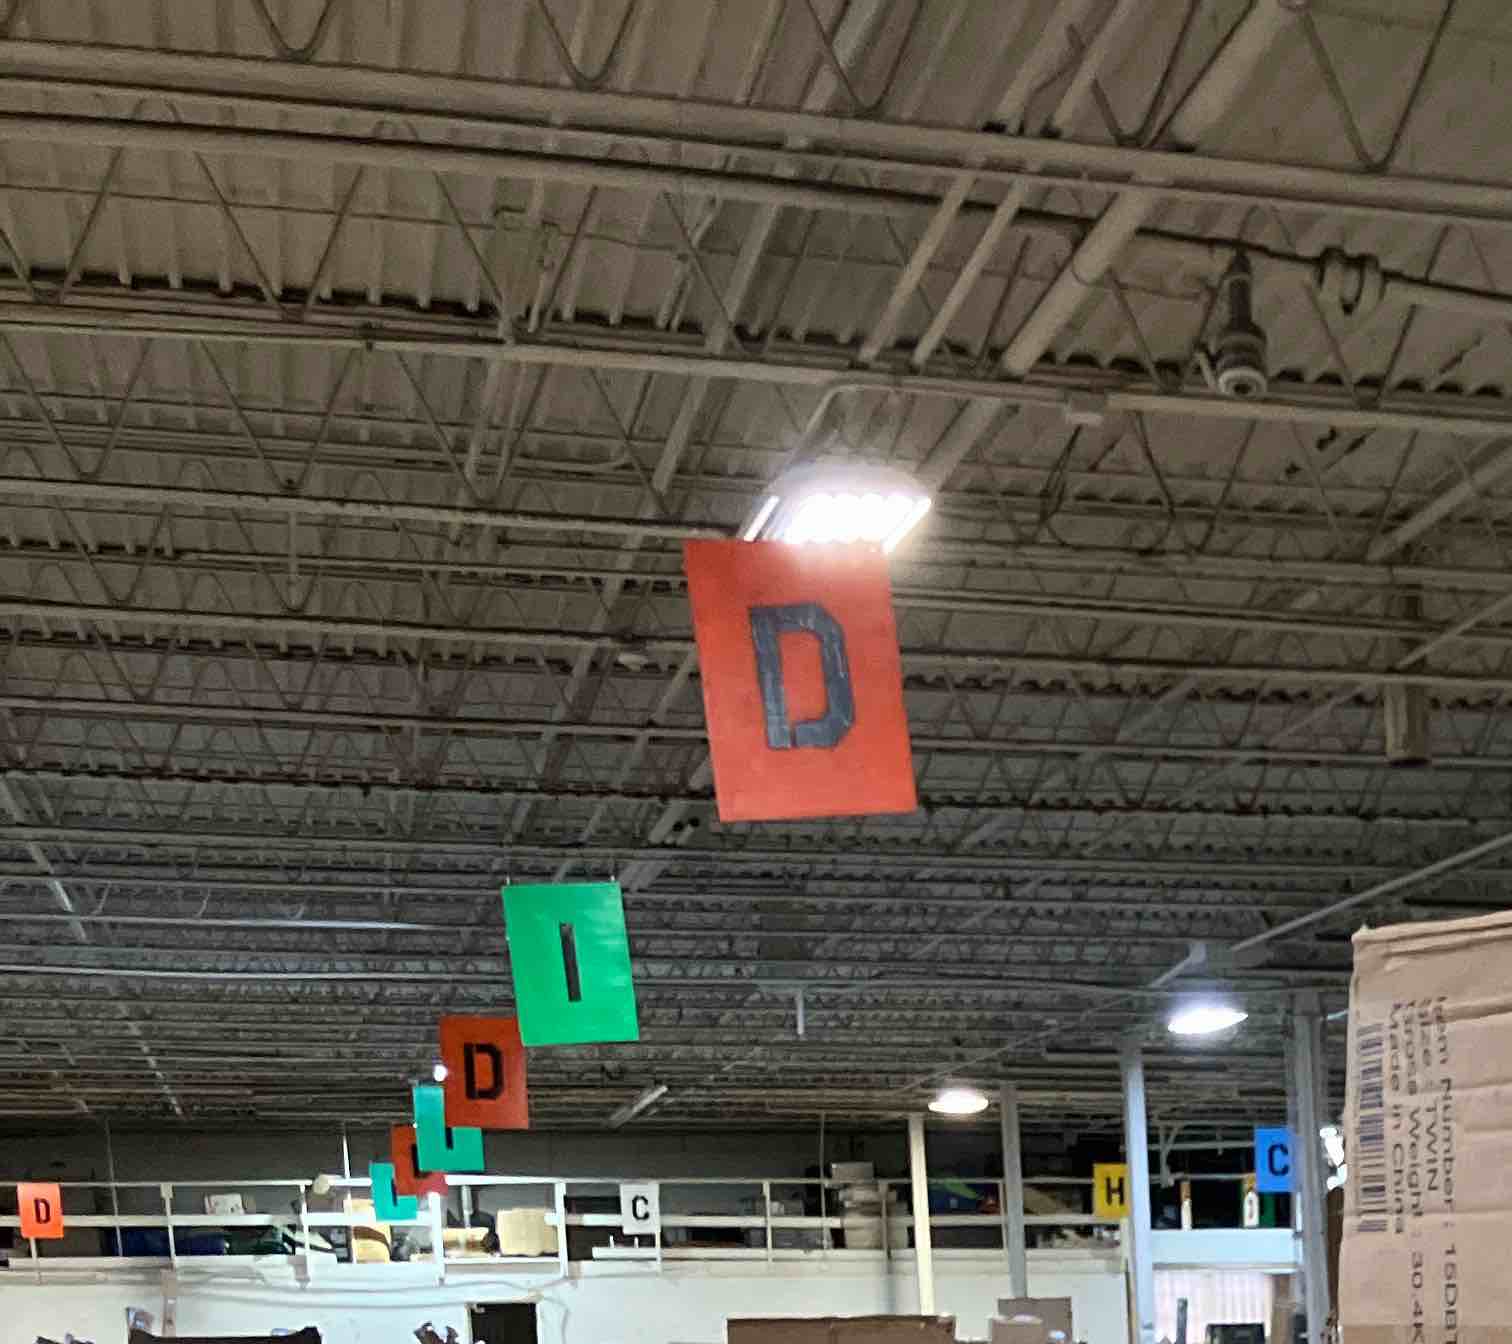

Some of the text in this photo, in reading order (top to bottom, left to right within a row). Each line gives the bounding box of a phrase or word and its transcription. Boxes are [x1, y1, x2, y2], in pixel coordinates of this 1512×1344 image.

[748, 601, 854, 750] D
[559, 923, 582, 1002] I
[464, 1043, 504, 1100] D
[1389, 1002, 1405, 1234] Made in China
[1425, 1100, 1440, 1191] TWIN
[1440, 1078, 1453, 1204] Number
[1105, 1176, 1126, 1206] H
[1267, 1143, 1290, 1177] C
[34, 1198, 51, 1224] D
[631, 1195, 650, 1221] C
